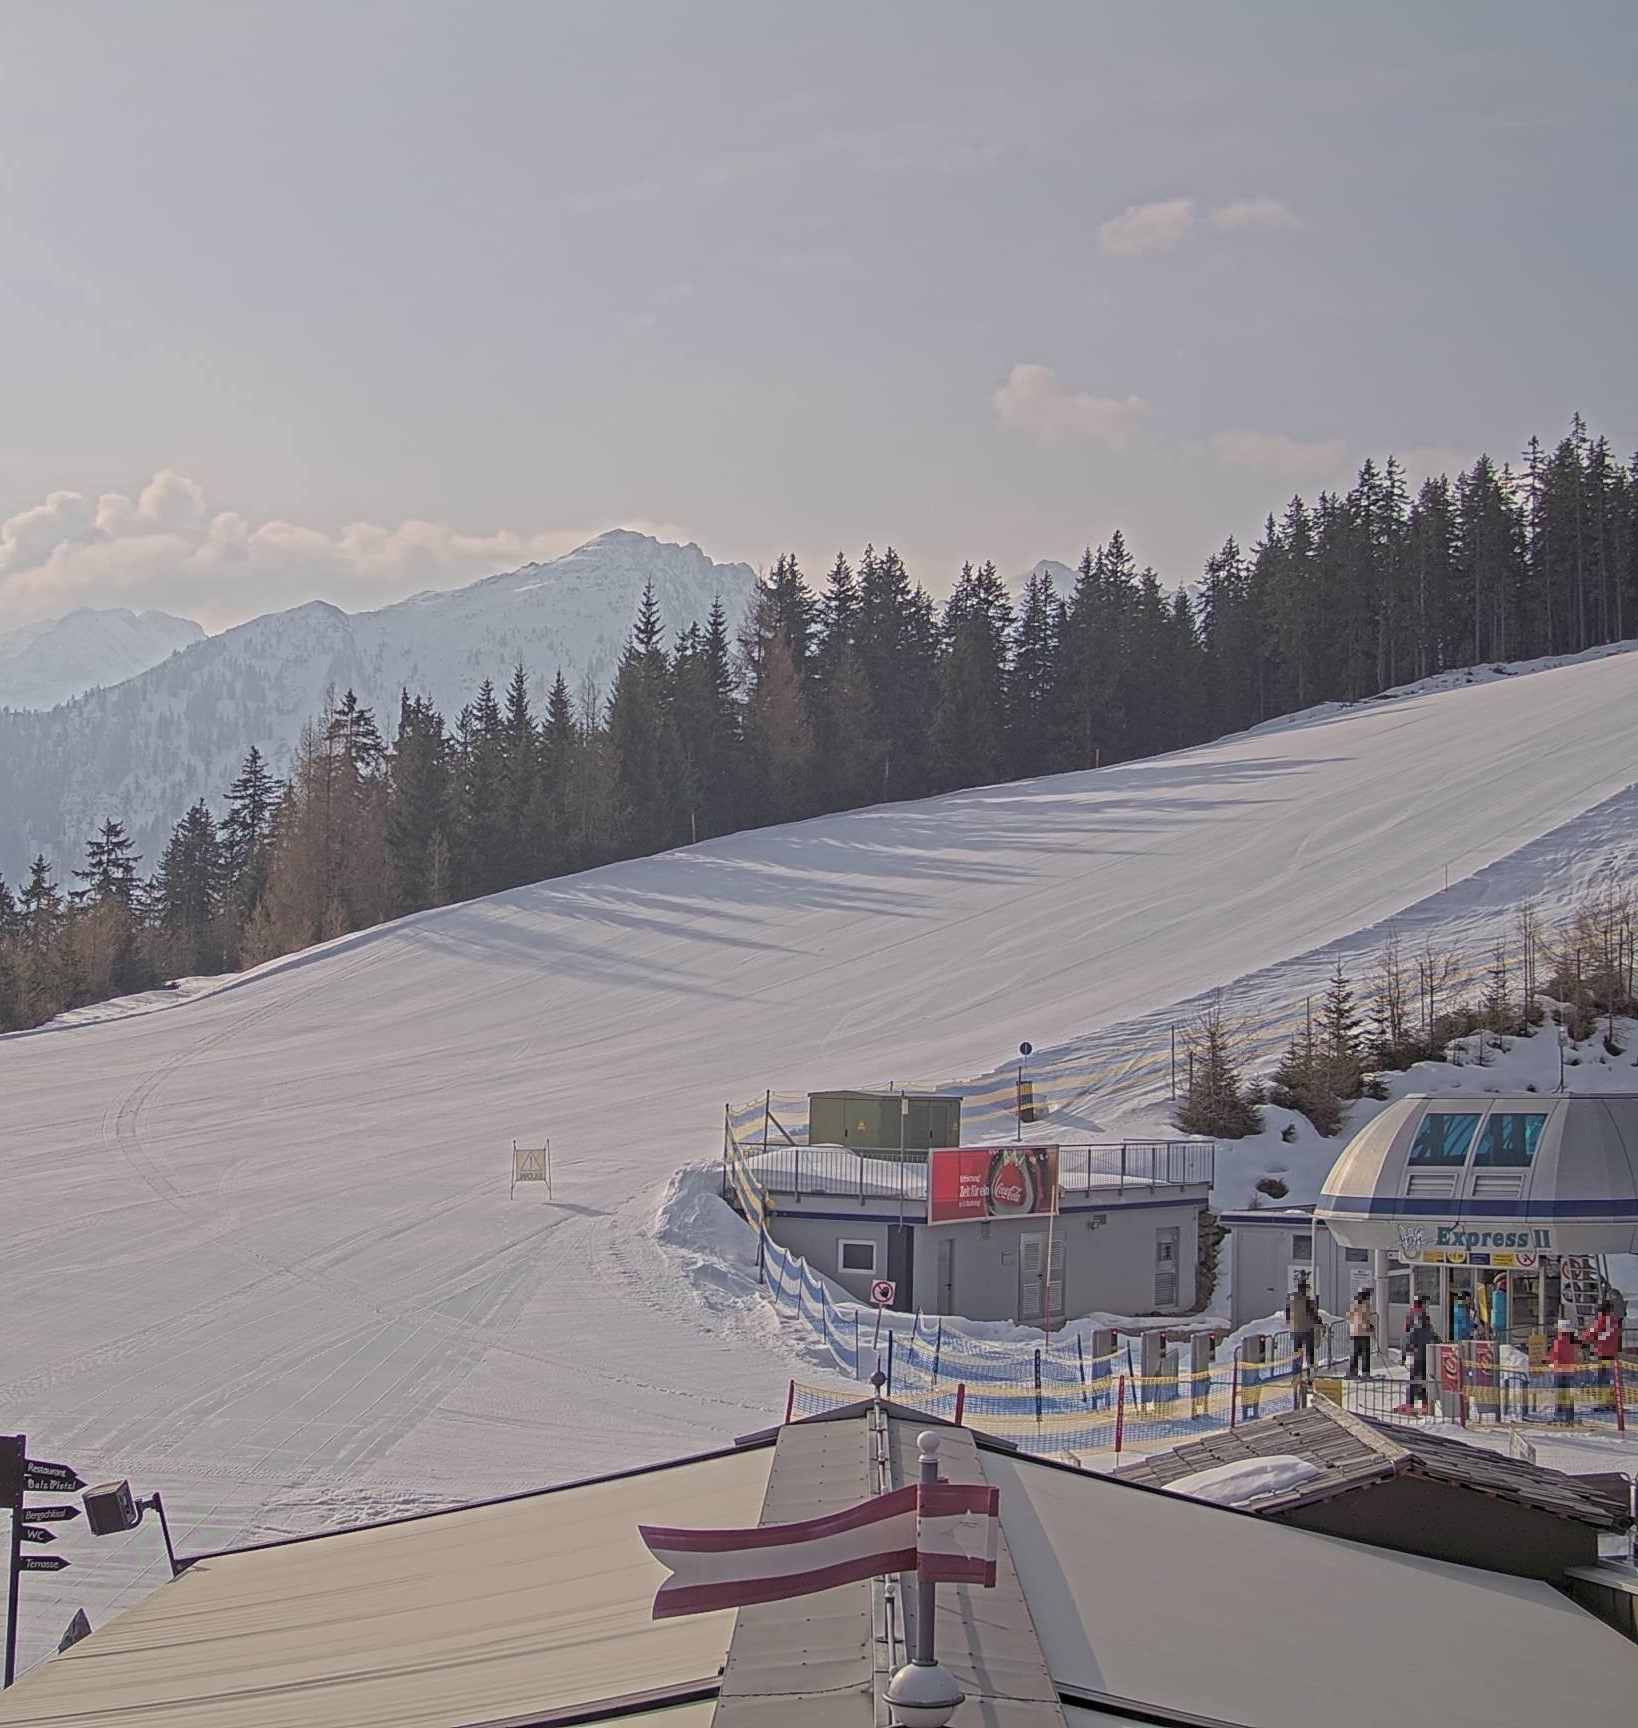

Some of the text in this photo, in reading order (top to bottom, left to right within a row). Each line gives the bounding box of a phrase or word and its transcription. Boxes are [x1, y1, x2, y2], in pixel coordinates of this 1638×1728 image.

[1436, 1226, 1529, 1251] Express
[27, 1462, 67, 1478] Restaurant
[27, 1529, 45, 1541] WC
[26, 1558, 60, 1569] Terrasse
